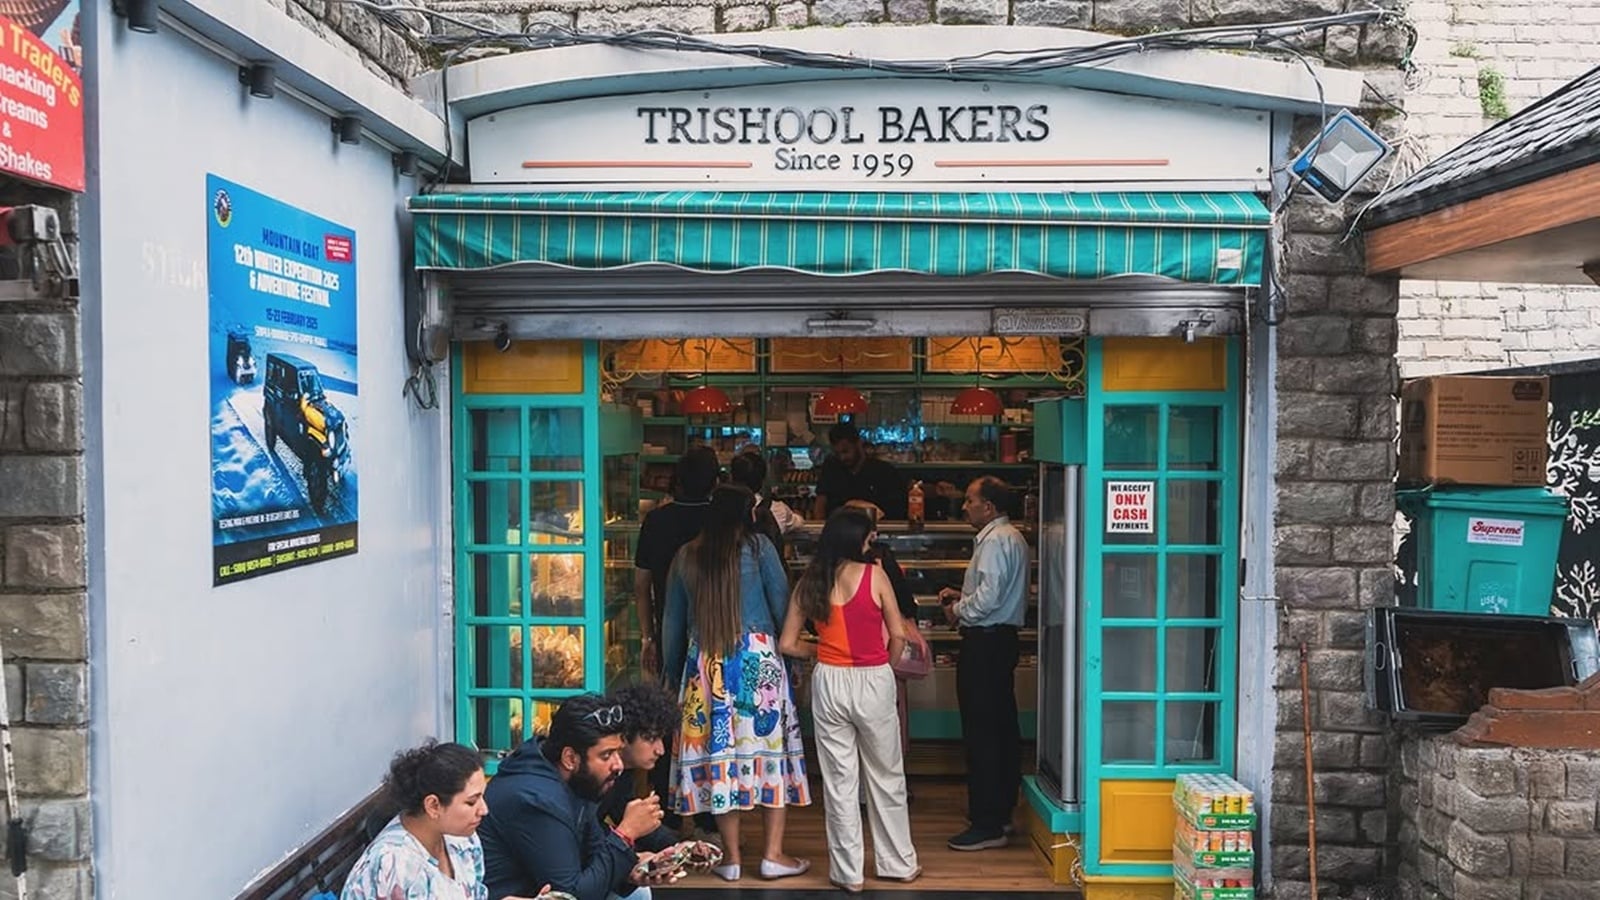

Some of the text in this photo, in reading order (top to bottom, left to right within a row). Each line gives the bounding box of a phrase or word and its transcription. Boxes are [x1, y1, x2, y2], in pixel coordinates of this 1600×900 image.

[10, 24, 81, 108] Traders
[0, 95, 48, 129] reams
[637, 104, 1050, 145] TRISHOOL BAKERS
[2, 120, 12, 138] &
[0, 141, 52, 180] Shakes
[775, 147, 914, 178] Since 1959
[262, 227, 301, 257] MOUNTAIN
[302, 241, 320, 261] GOAT
[234, 243, 254, 268] 12th
[323, 271, 340, 292] 2025
[257, 271, 301, 300] ADVENTURE
[301, 284, 331, 308] FESTIVAL
[1110, 484, 1151, 492] WE ACCEPT
[1115, 493, 1146, 505] ONLY
[1111, 522, 1149, 530] PAYMENTS
[1113, 508, 1147, 520] CASH
[1471, 520, 1522, 536] Supreme
